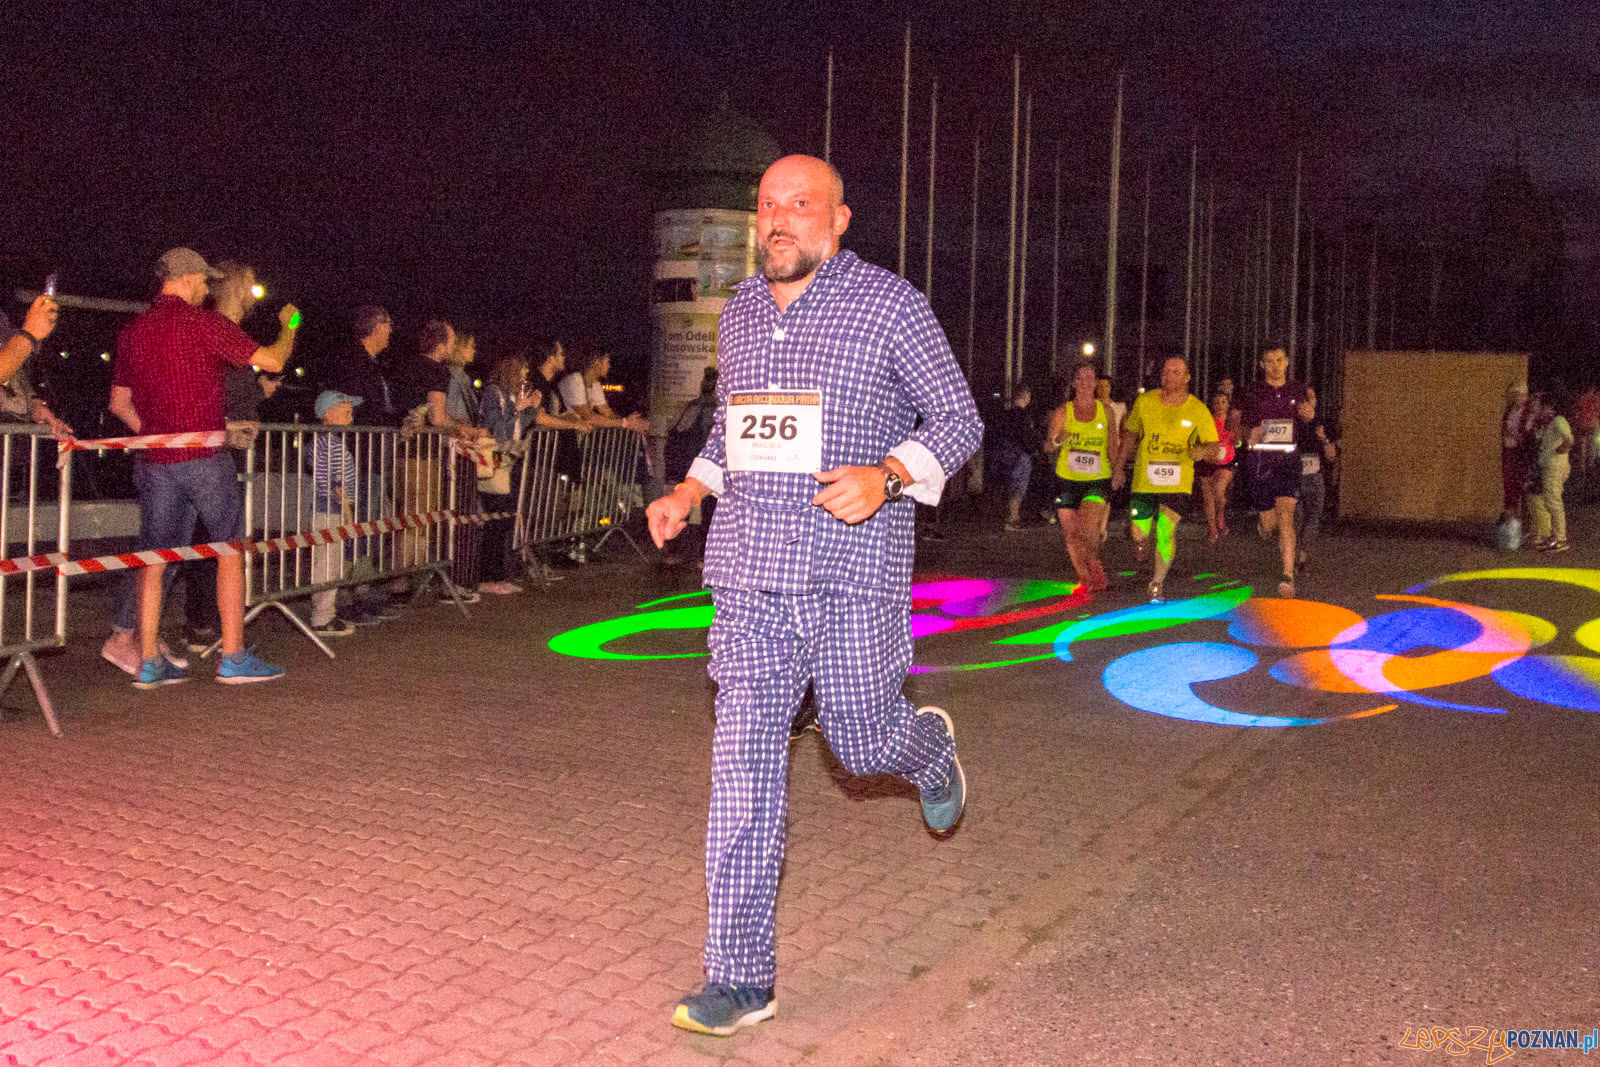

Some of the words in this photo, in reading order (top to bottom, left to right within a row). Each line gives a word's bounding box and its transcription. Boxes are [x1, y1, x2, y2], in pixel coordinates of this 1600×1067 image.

[686, 331, 715, 341] Odell
[740, 415, 798, 440] 256
[1269, 426, 1287, 434] 407
[1075, 456, 1095, 465] 458
[1154, 468, 1174, 476] 459
